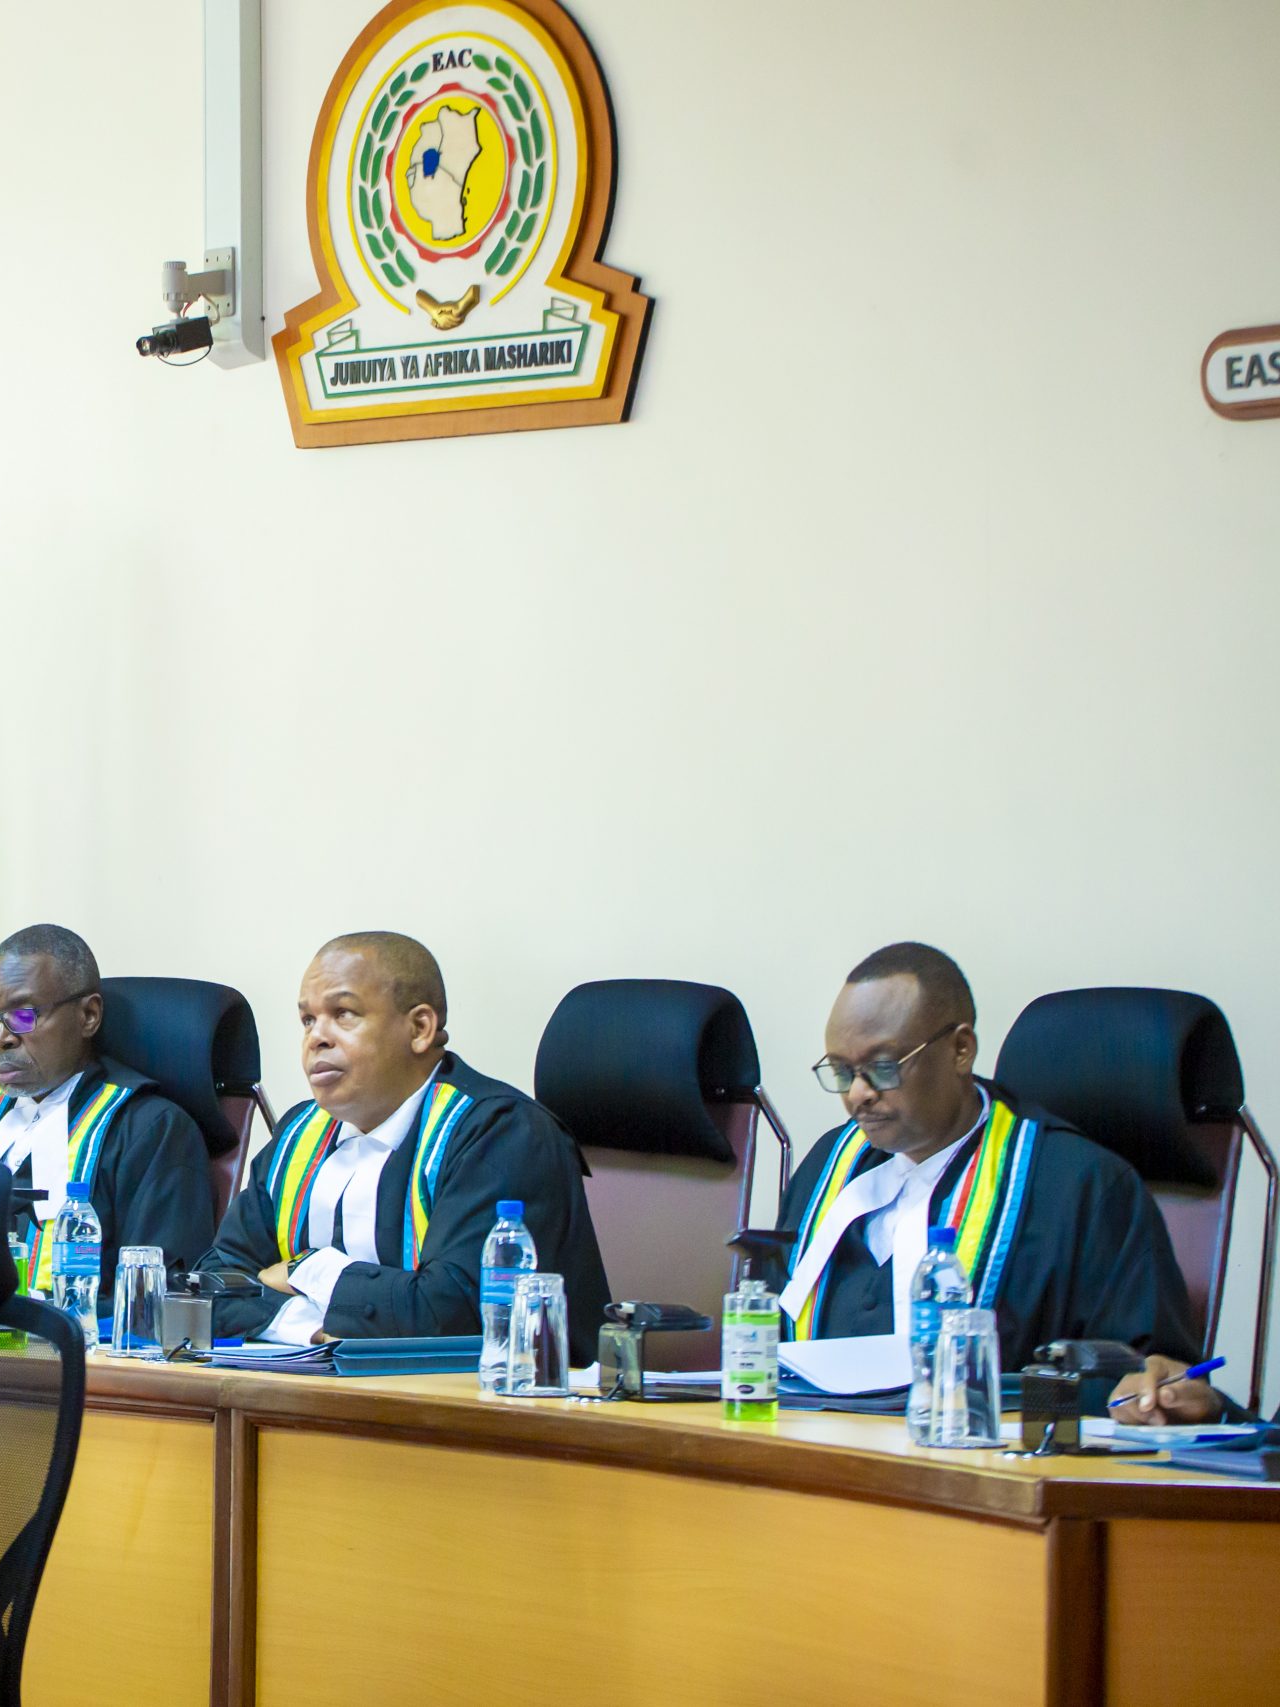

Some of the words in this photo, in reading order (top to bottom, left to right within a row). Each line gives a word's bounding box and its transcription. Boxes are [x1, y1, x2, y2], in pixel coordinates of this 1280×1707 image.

[432, 48, 472, 73] EAC
[330, 356, 397, 387] JUMUIYA
[400, 354, 420, 380] YA
[423, 348, 480, 377] AFRIKA
[484, 338, 573, 372] MASHARIKI
